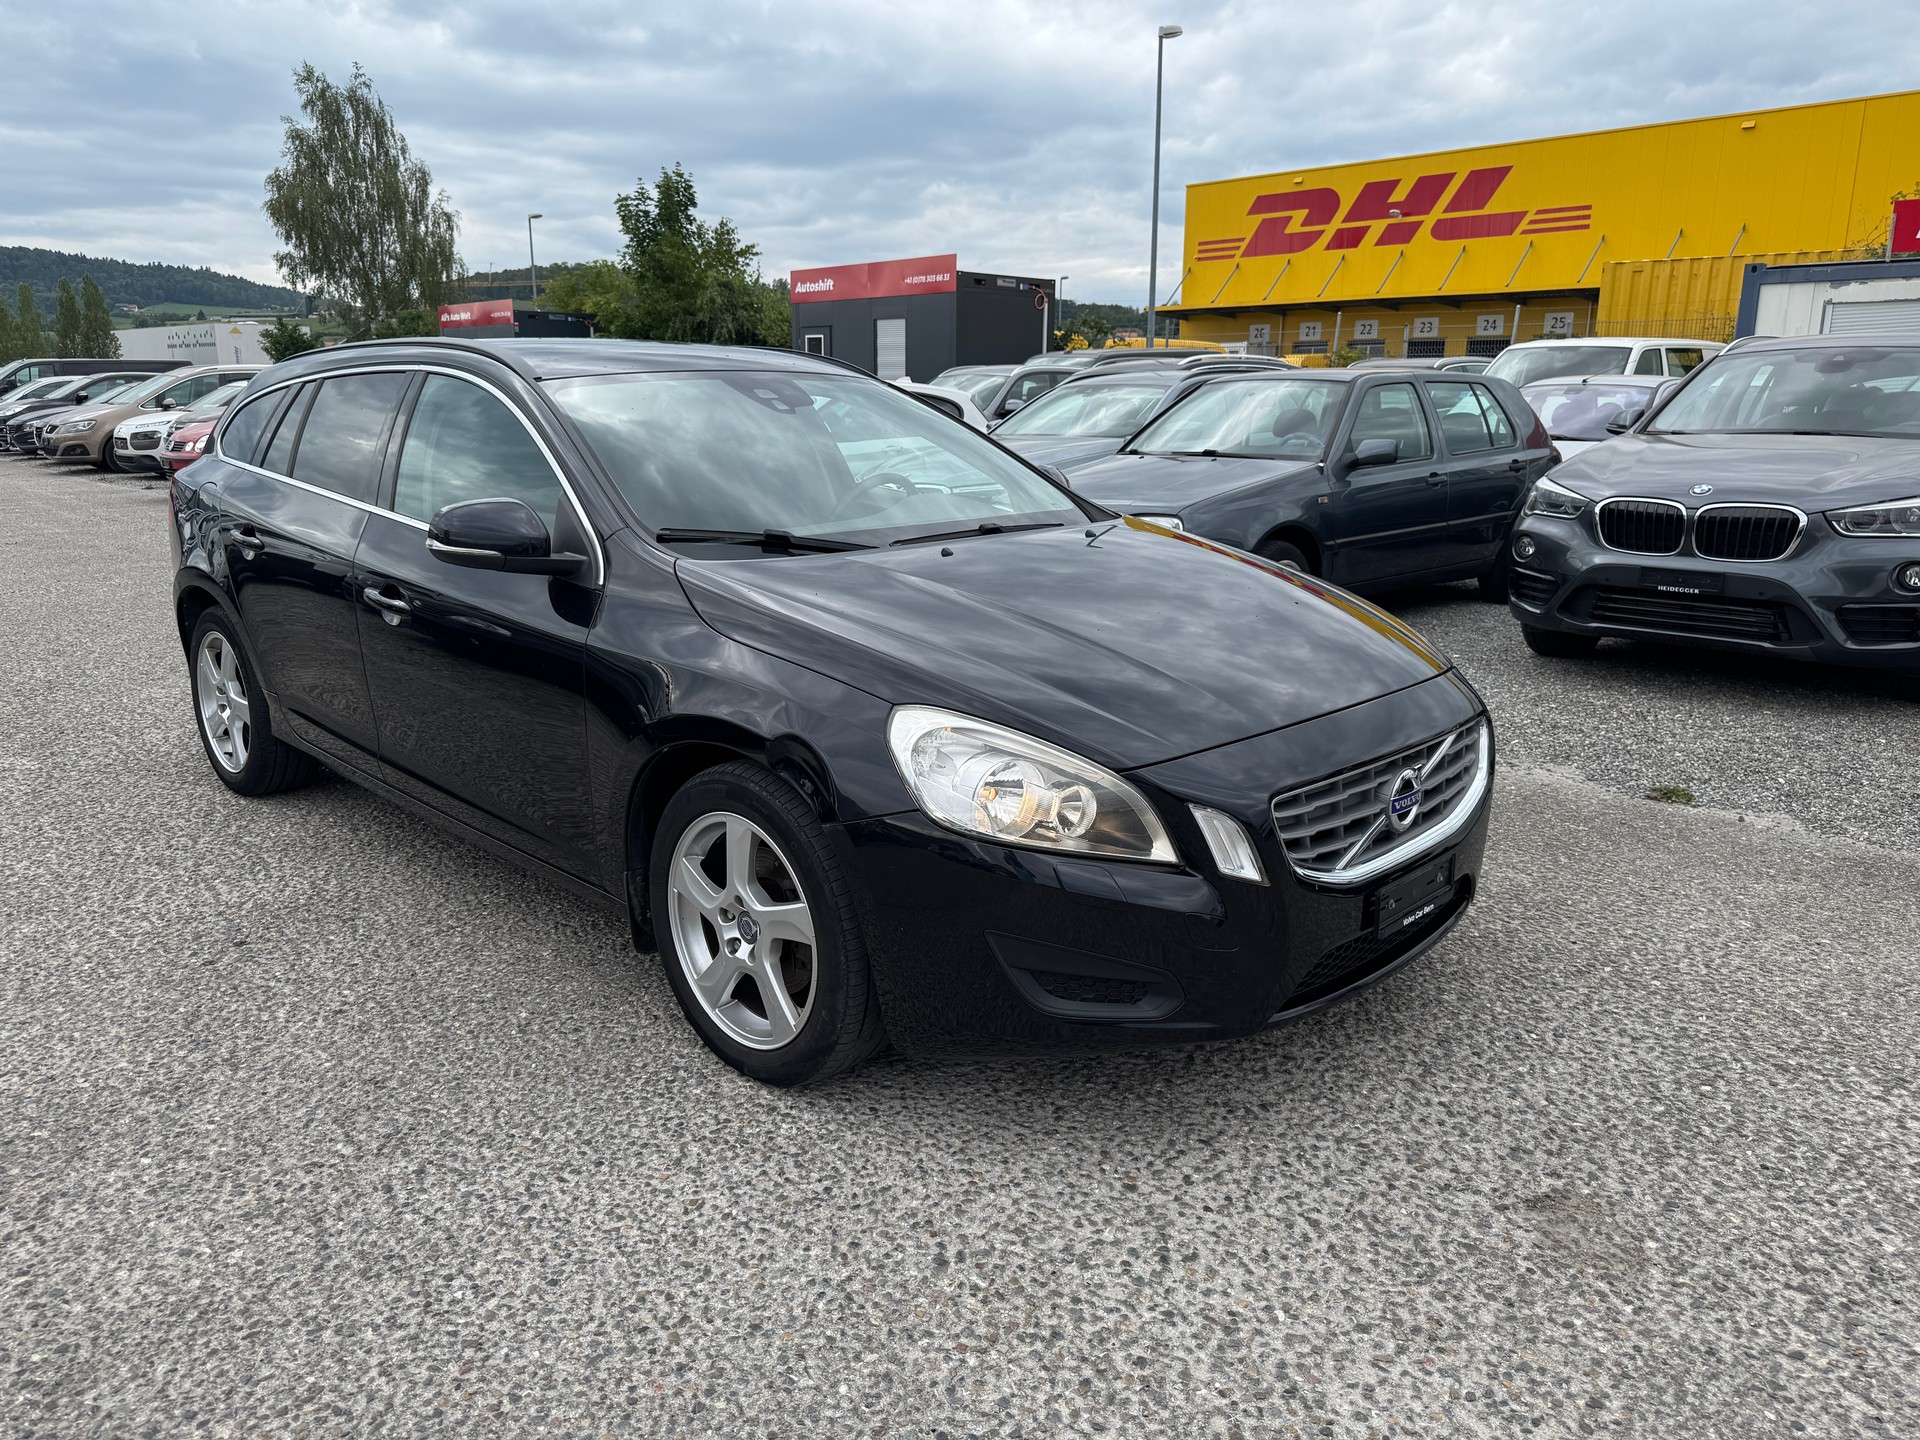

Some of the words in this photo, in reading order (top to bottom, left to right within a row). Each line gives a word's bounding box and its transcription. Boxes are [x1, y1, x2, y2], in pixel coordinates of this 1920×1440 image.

[1240, 165, 1529, 258] DHL
[936, 273, 944, 282] 66
[795, 278, 834, 293] Autoshift
[1419, 322, 1433, 333] 23
[1482, 319, 1497, 331] 24
[1550, 317, 1566, 329] 25
[1305, 326, 1316, 337] 21
[1360, 324, 1373, 335] 22
[1657, 585, 1699, 594] HEIDEGGER
[1403, 915, 1415, 926] Volvo
[1415, 910, 1424, 919] Car
[1423, 904, 1434, 914] Bern
